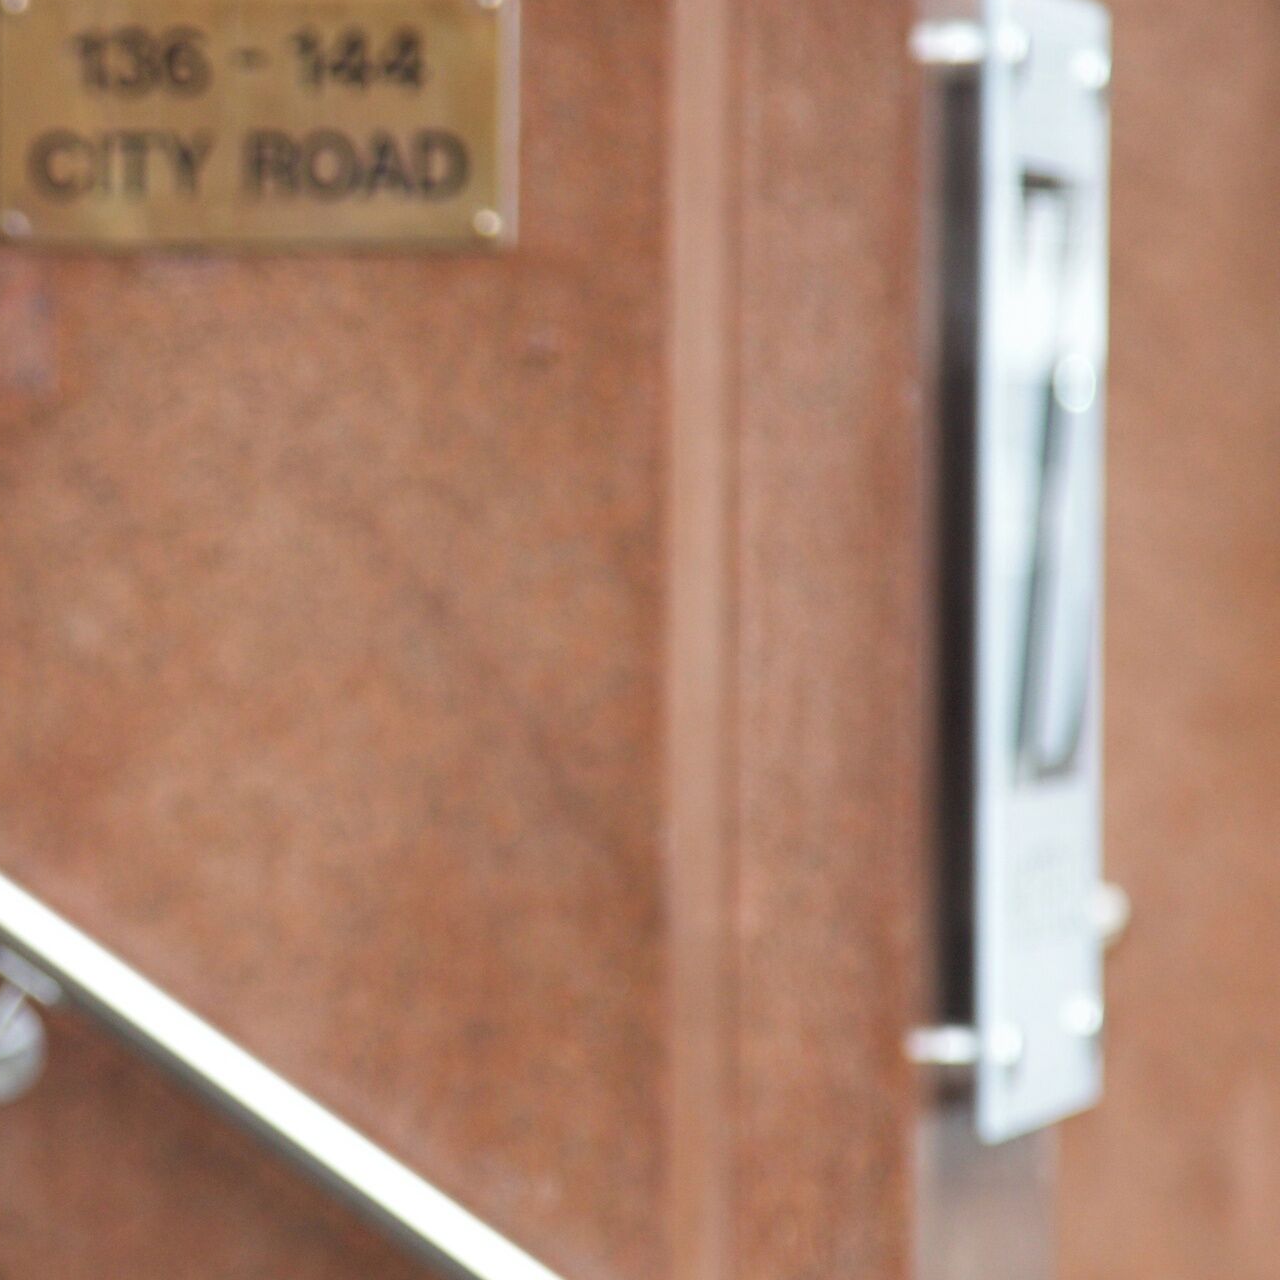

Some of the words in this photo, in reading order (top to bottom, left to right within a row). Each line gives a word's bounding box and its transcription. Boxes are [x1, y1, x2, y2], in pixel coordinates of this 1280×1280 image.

[72, 24, 214, 98] 136
[292, 24, 427, 92] 144
[28, 127, 216, 201] CITY
[240, 127, 472, 201] ROAD
